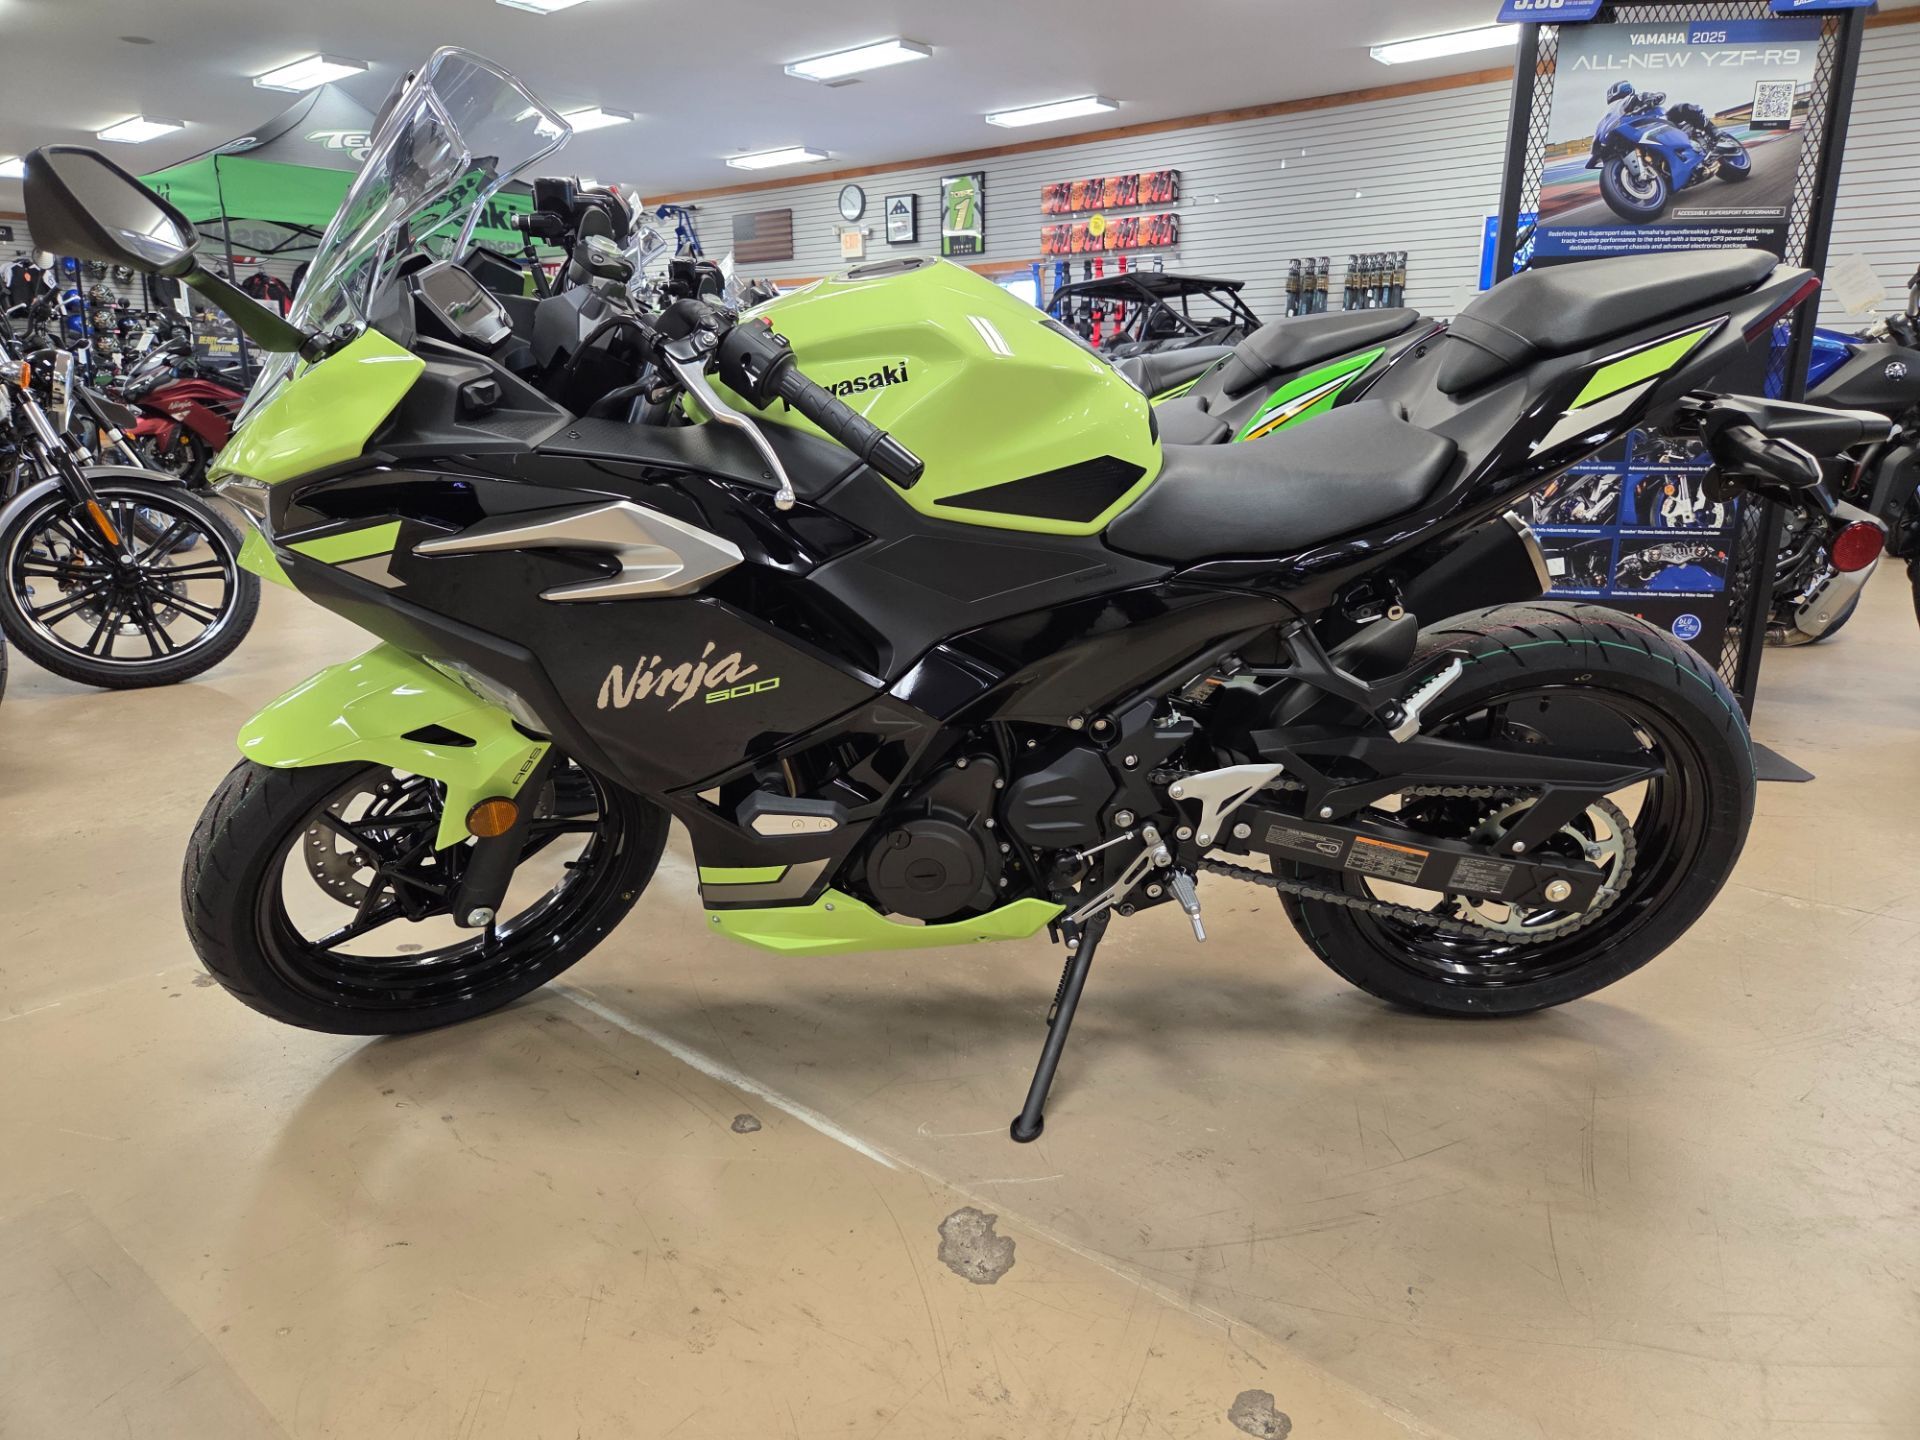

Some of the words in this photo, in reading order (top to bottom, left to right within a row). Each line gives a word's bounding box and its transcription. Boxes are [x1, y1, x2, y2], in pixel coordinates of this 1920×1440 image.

[1630, 32, 1686, 45] YAMAHA
[1692, 32, 1726, 43] 2025
[1572, 52, 1692, 70] ALL-NEW
[1701, 49, 1800, 66] YZF-R9
[597, 642, 759, 712] Ninja
[706, 678, 780, 704] 500
[512, 747, 542, 784] ABS
